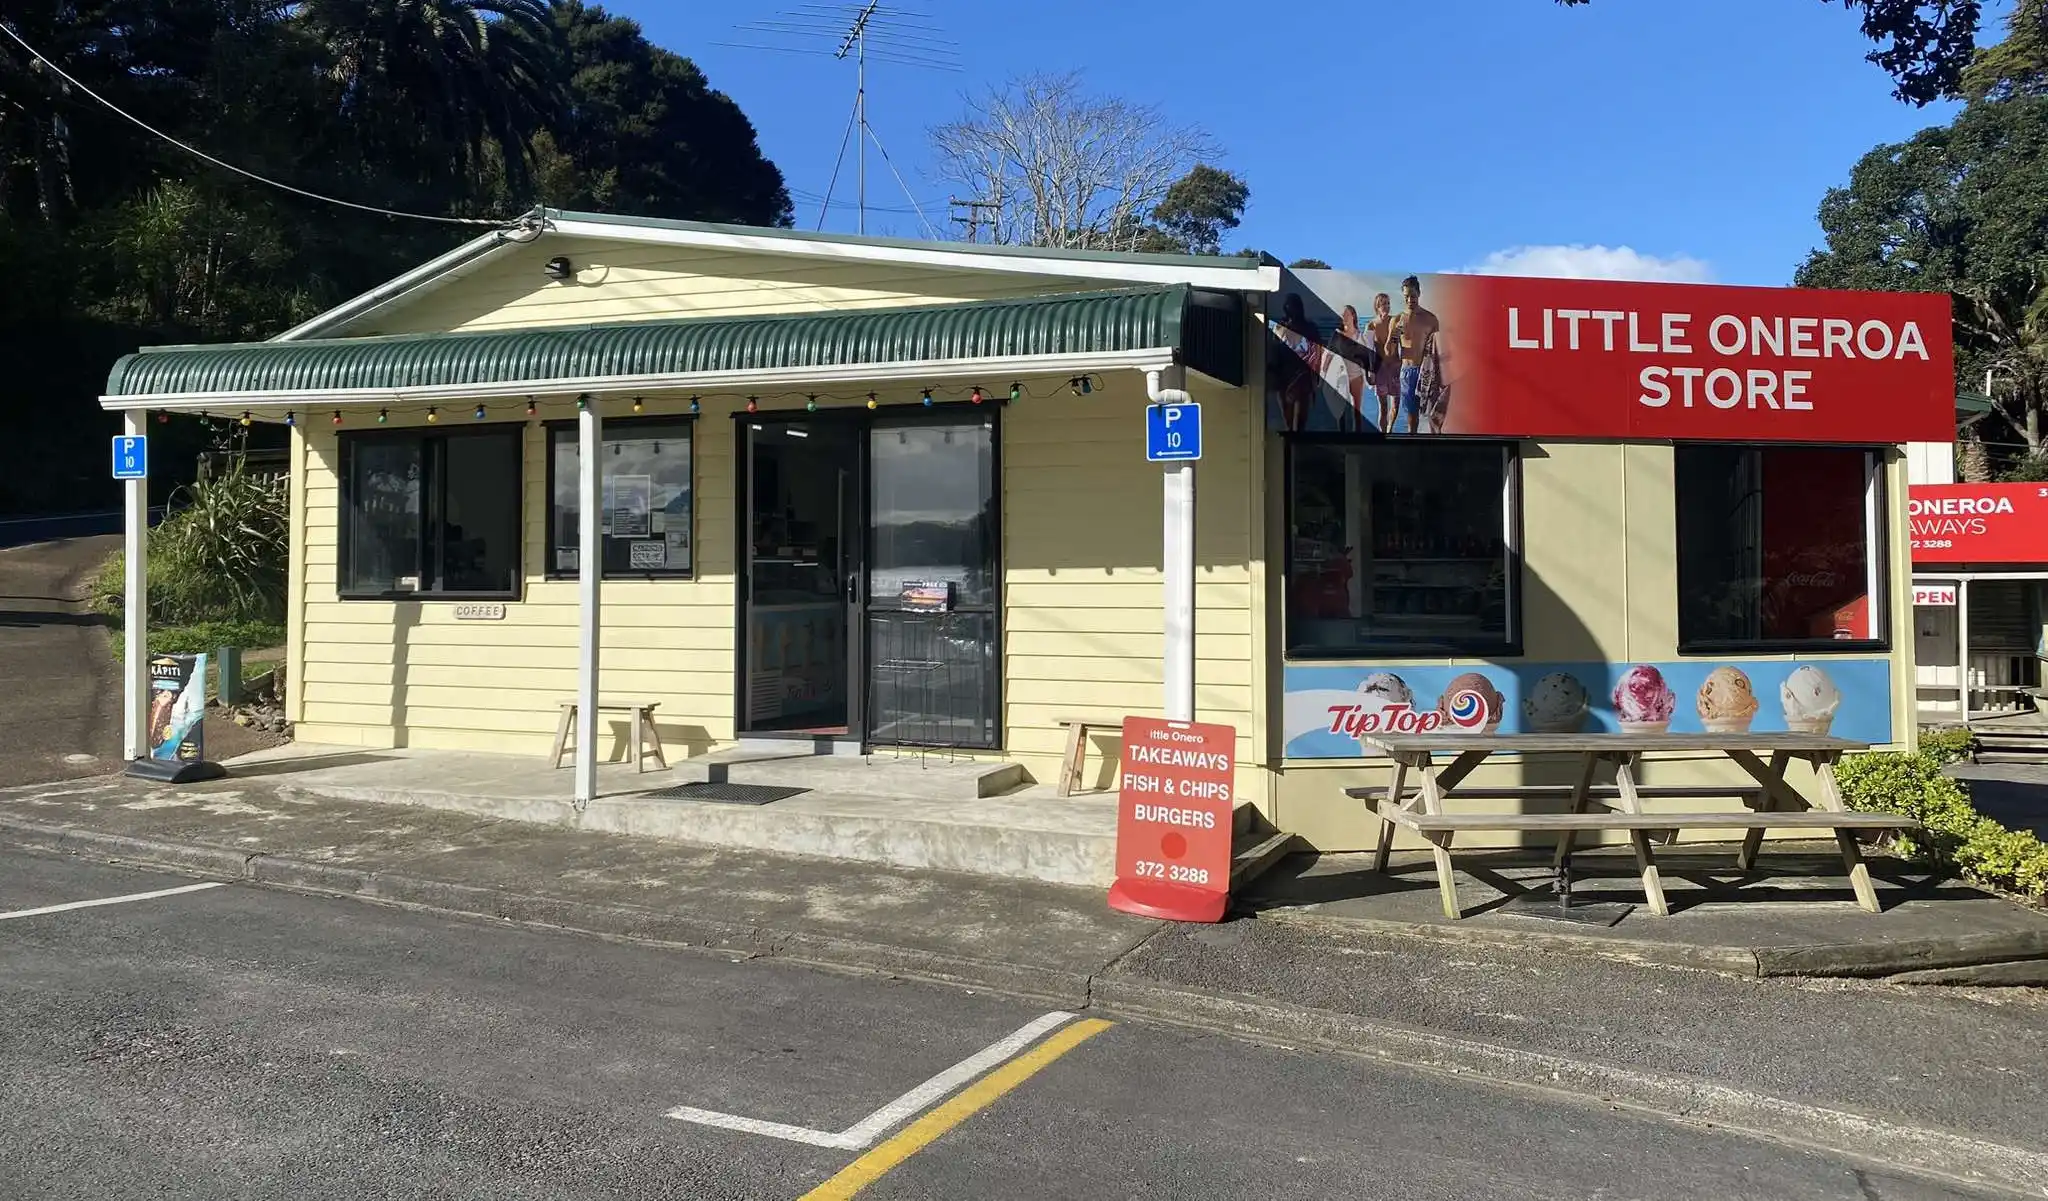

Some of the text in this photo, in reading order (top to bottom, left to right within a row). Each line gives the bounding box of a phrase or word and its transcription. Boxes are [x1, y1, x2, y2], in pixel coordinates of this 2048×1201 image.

[1508, 307, 1929, 361] LITTLE ONEROA
[1639, 366, 1814, 410] STORE
[1165, 408, 1181, 429] P
[124, 438, 135, 454] P
[1167, 432, 1181, 448] 10
[125, 456, 135, 468] 10
[1922, 540, 1952, 548] 3288
[1912, 591, 1954, 603] PEN
[456, 605, 500, 616] COFFEE
[1129, 744, 1229, 771] TAKEAWAYS
[1123, 774, 1229, 801] FISH & CHIPS
[1135, 804, 1215, 829] BURGERS
[1136, 861, 1208, 884] 372 3288
